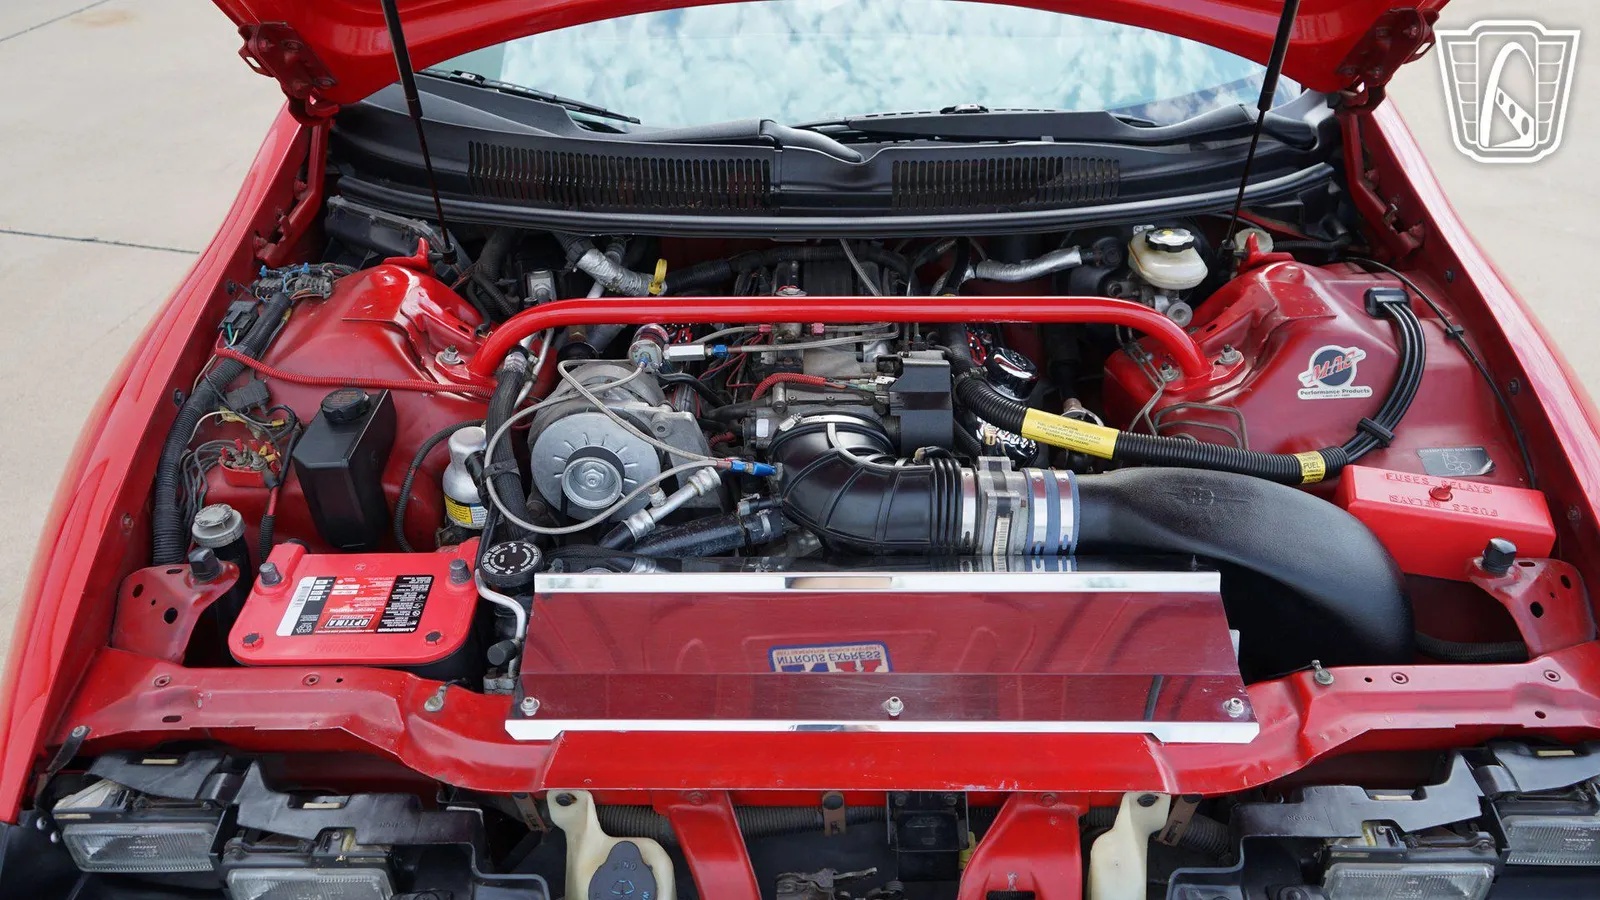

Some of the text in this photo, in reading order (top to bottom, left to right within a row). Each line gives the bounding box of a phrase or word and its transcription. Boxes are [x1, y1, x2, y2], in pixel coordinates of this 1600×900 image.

[1311, 351, 1356, 381] MAC
[1302, 461, 1321, 469] FUEL
[1386, 472, 1493, 495] FUSES RELAYS
[1389, 494, 1499, 517] FUSES RELAYS
[328, 618, 369, 627] OPTIMA
